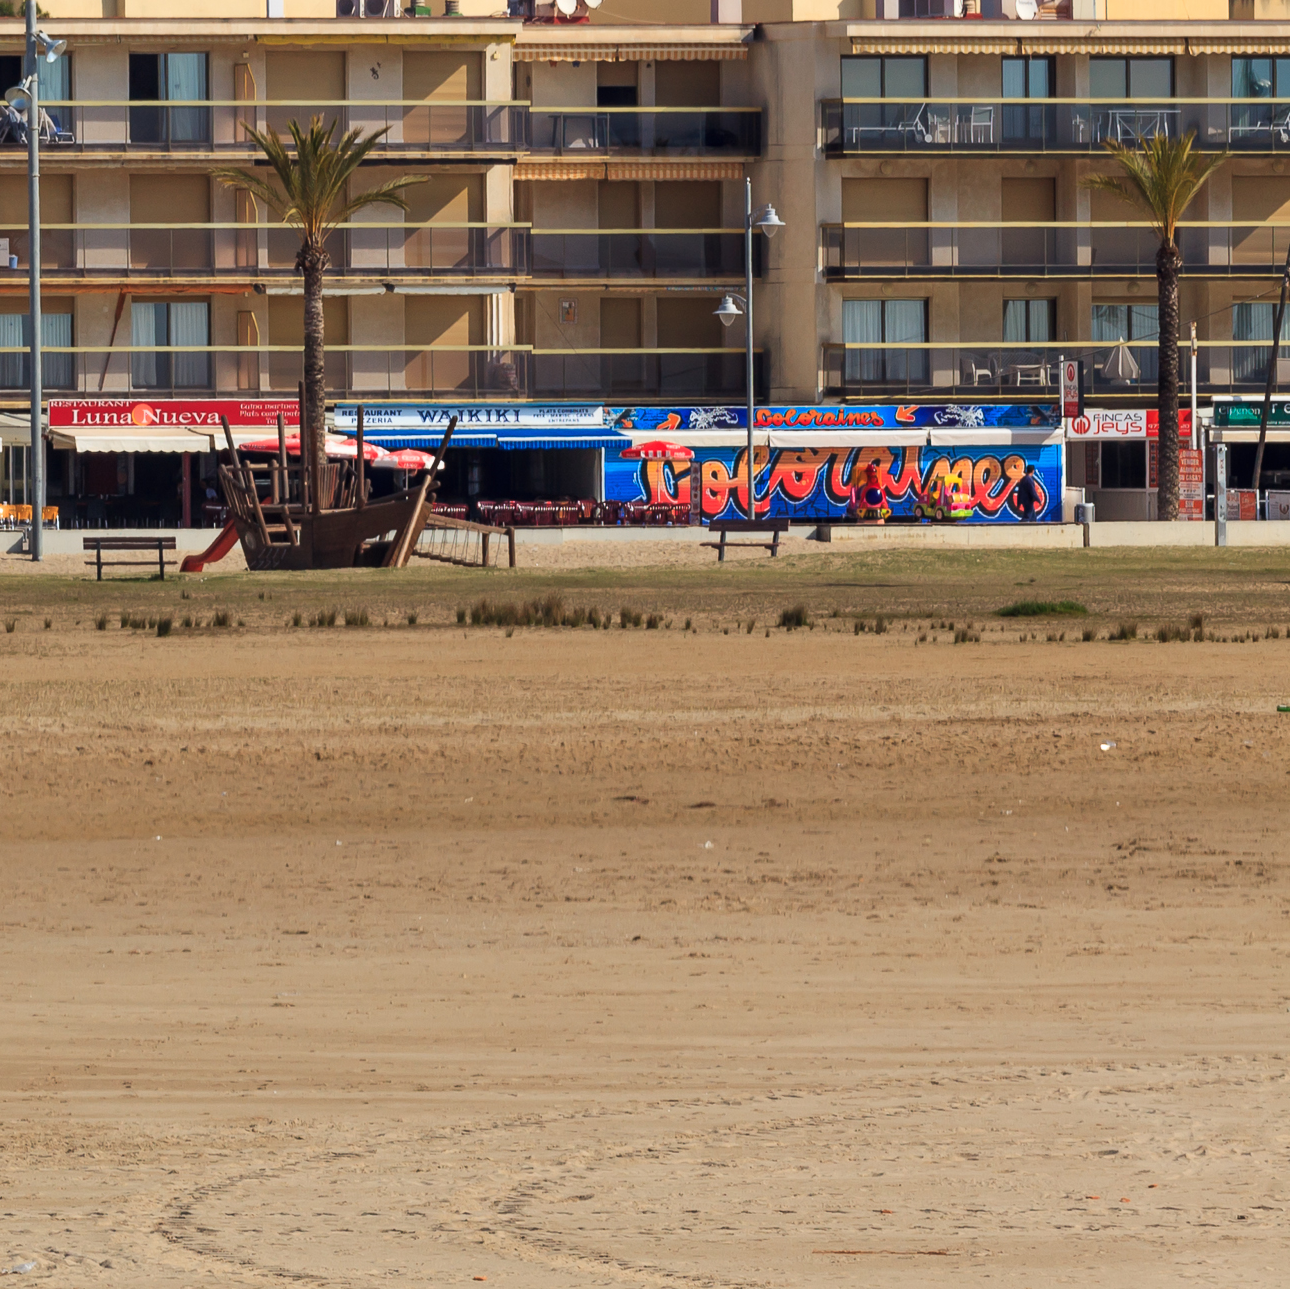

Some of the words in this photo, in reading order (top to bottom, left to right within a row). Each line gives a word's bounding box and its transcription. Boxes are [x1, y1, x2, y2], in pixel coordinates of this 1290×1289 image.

[71, 408, 133, 425] Luna
[141, 409, 221, 424] Nueva
[266, 417, 289, 425] Taps
[417, 408, 521, 423] WAIKIKI
[753, 407, 884, 428] Coloraines
[1093, 413, 1143, 422] FINCAS
